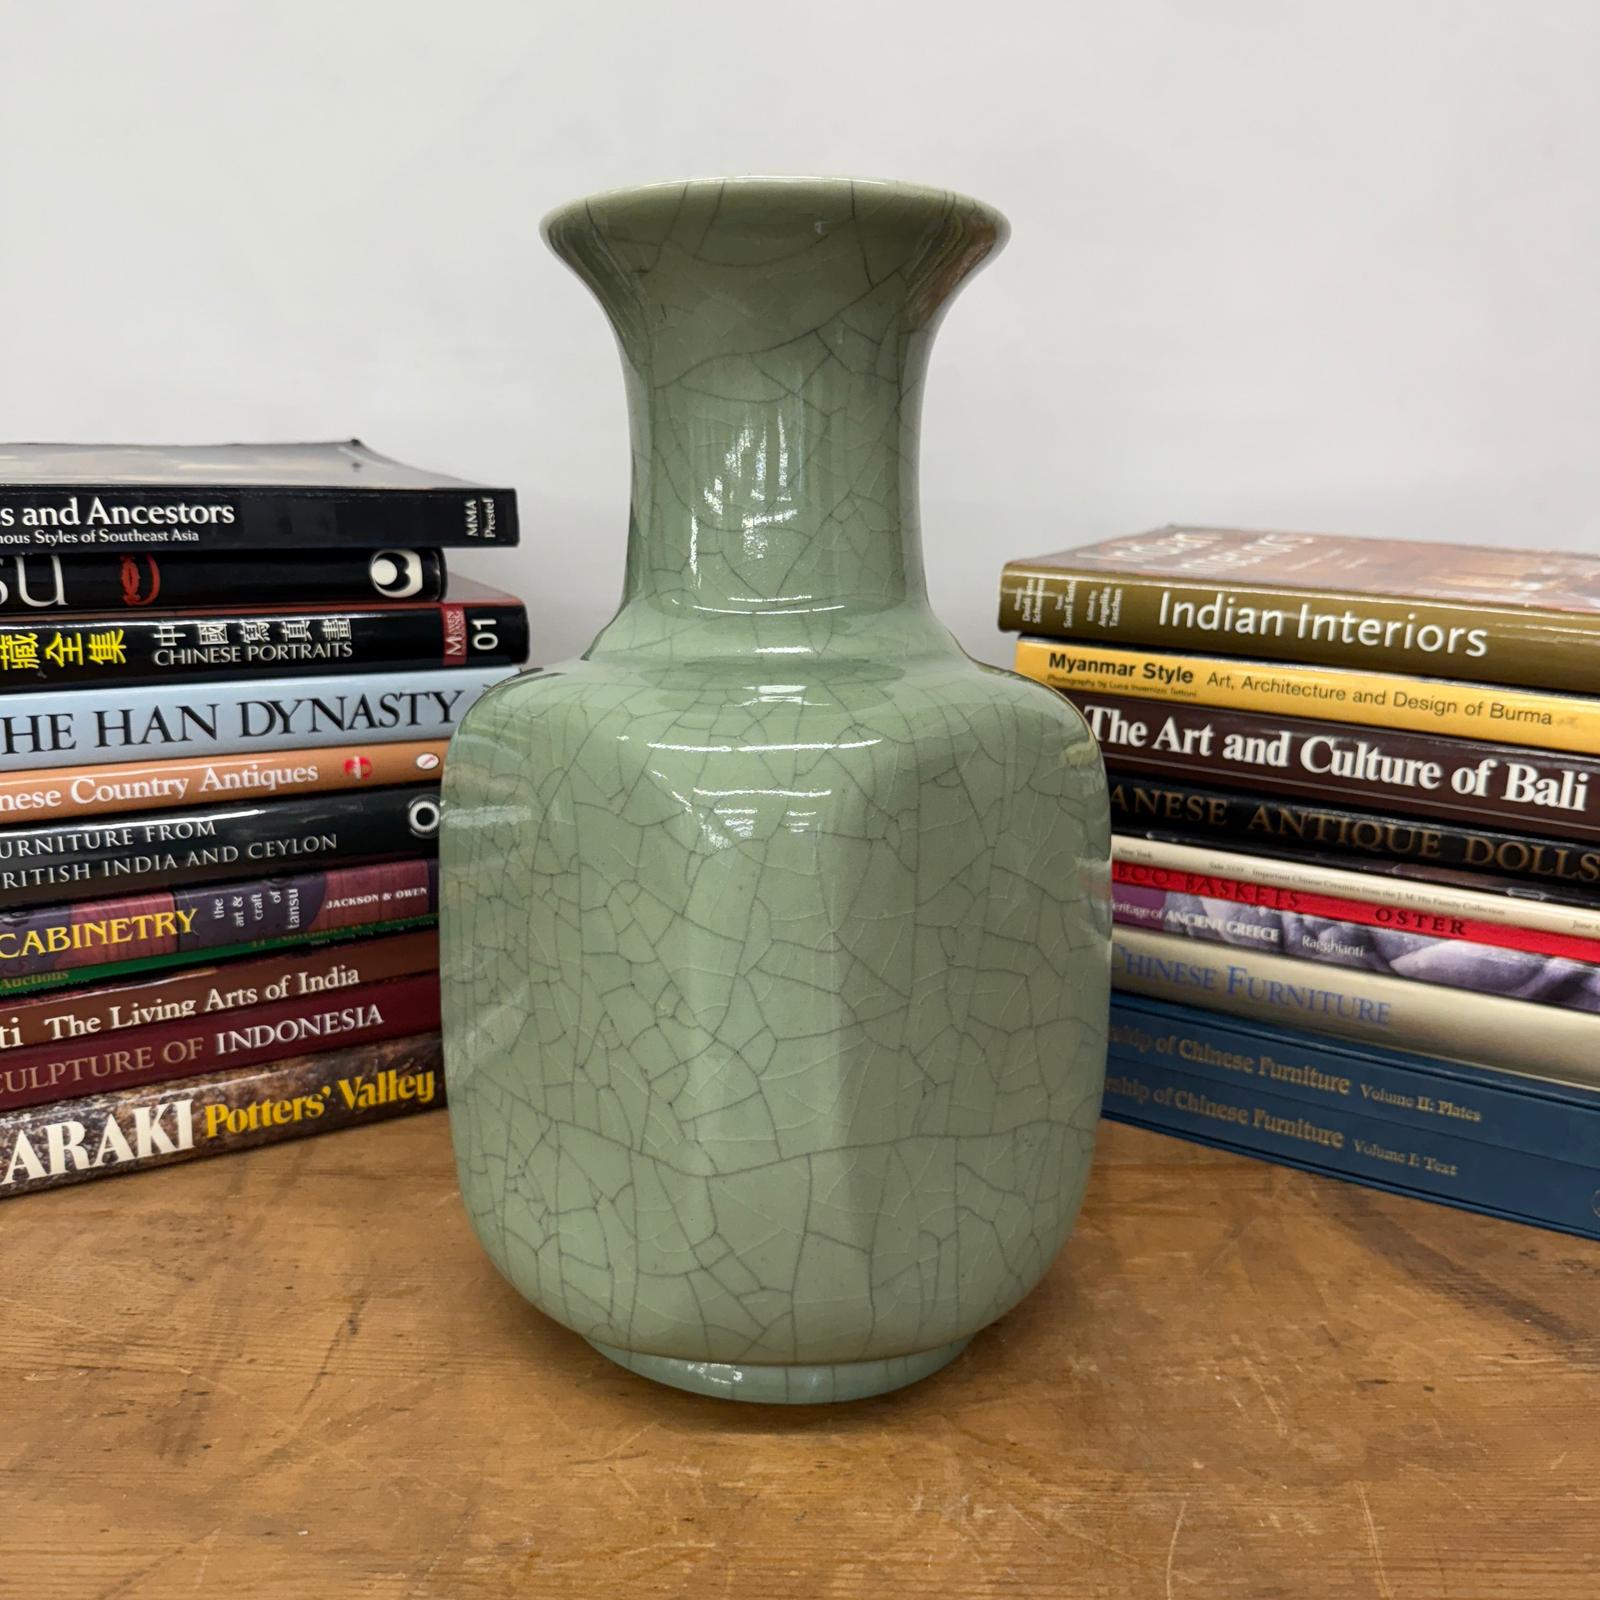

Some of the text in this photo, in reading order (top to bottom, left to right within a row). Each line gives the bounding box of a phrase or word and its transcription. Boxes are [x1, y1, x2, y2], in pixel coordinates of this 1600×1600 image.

[0, 496, 235, 527] s and Ancestors
[465, 500, 479, 537] MMA
[482, 497, 496, 539] Prestel
[34, 529, 78, 547] Styles
[81, 529, 97, 544] of
[100, 528, 169, 544] Southeast
[171, 527, 200, 542] Asia
[472, 618, 499, 650] 01
[1159, 591, 1488, 657] Indian Interiors
[154, 641, 353, 666] CHINESE PORTRAITS
[1049, 652, 1193, 684] Myanmar Style
[1206, 672, 1552, 726] Art, Architecture and Design of Burma
[0, 690, 465, 755] HE HAN DYNASTY
[1084, 705, 1589, 811] The Art and Culture of Bali
[70, 776, 190, 805] Country
[198, 763, 319, 792] Antiques
[0, 821, 217, 859] URNITURE FROM
[1111, 784, 1600, 882] ANESE ANTIQUE DOLLS
[2, 834, 337, 890] RITISH INDIA AND CEYLON
[269, 890, 281, 904] of
[326, 887, 428, 909] JACKSON & OWEN
[1118, 862, 1299, 907] BOO BASKETS
[214, 897, 224, 919] the
[233, 896, 245, 927] art &
[250, 893, 263, 921] craft
[286, 888, 300, 929] tansu
[1164, 910, 1225, 932] ANCIENT
[1226, 920, 1281, 943] GREECE
[1375, 907, 1467, 936] OSTER
[0, 908, 198, 958] CABINETRY
[1302, 935, 1364, 957] Ragghianti
[44, 1014, 101, 1040] The
[109, 998, 196, 1030] Living
[204, 988, 258, 1013] Arts
[265, 974, 291, 1001] of
[297, 964, 360, 994] India
[1227, 965, 1392, 1026] FURNITURE
[0, 1003, 384, 1094] ULPTURE OF INDONESIA
[1156, 1034, 1177, 1055] of
[1179, 1038, 1254, 1073] Chinese
[1258, 1056, 1351, 1096] Furniture
[1153, 1086, 1175, 1106] of
[1175, 1090, 1249, 1125] Chinese
[1253, 1107, 1344, 1148] Furniture
[1360, 1084, 1414, 1108] Volume
[1438, 1100, 1481, 1122] Plates
[2, 1099, 195, 1185] ARAKI
[338, 1070, 436, 1110] Valley
[1352, 1139, 1406, 1164] Volume
[1424, 1156, 1458, 1177] Text
